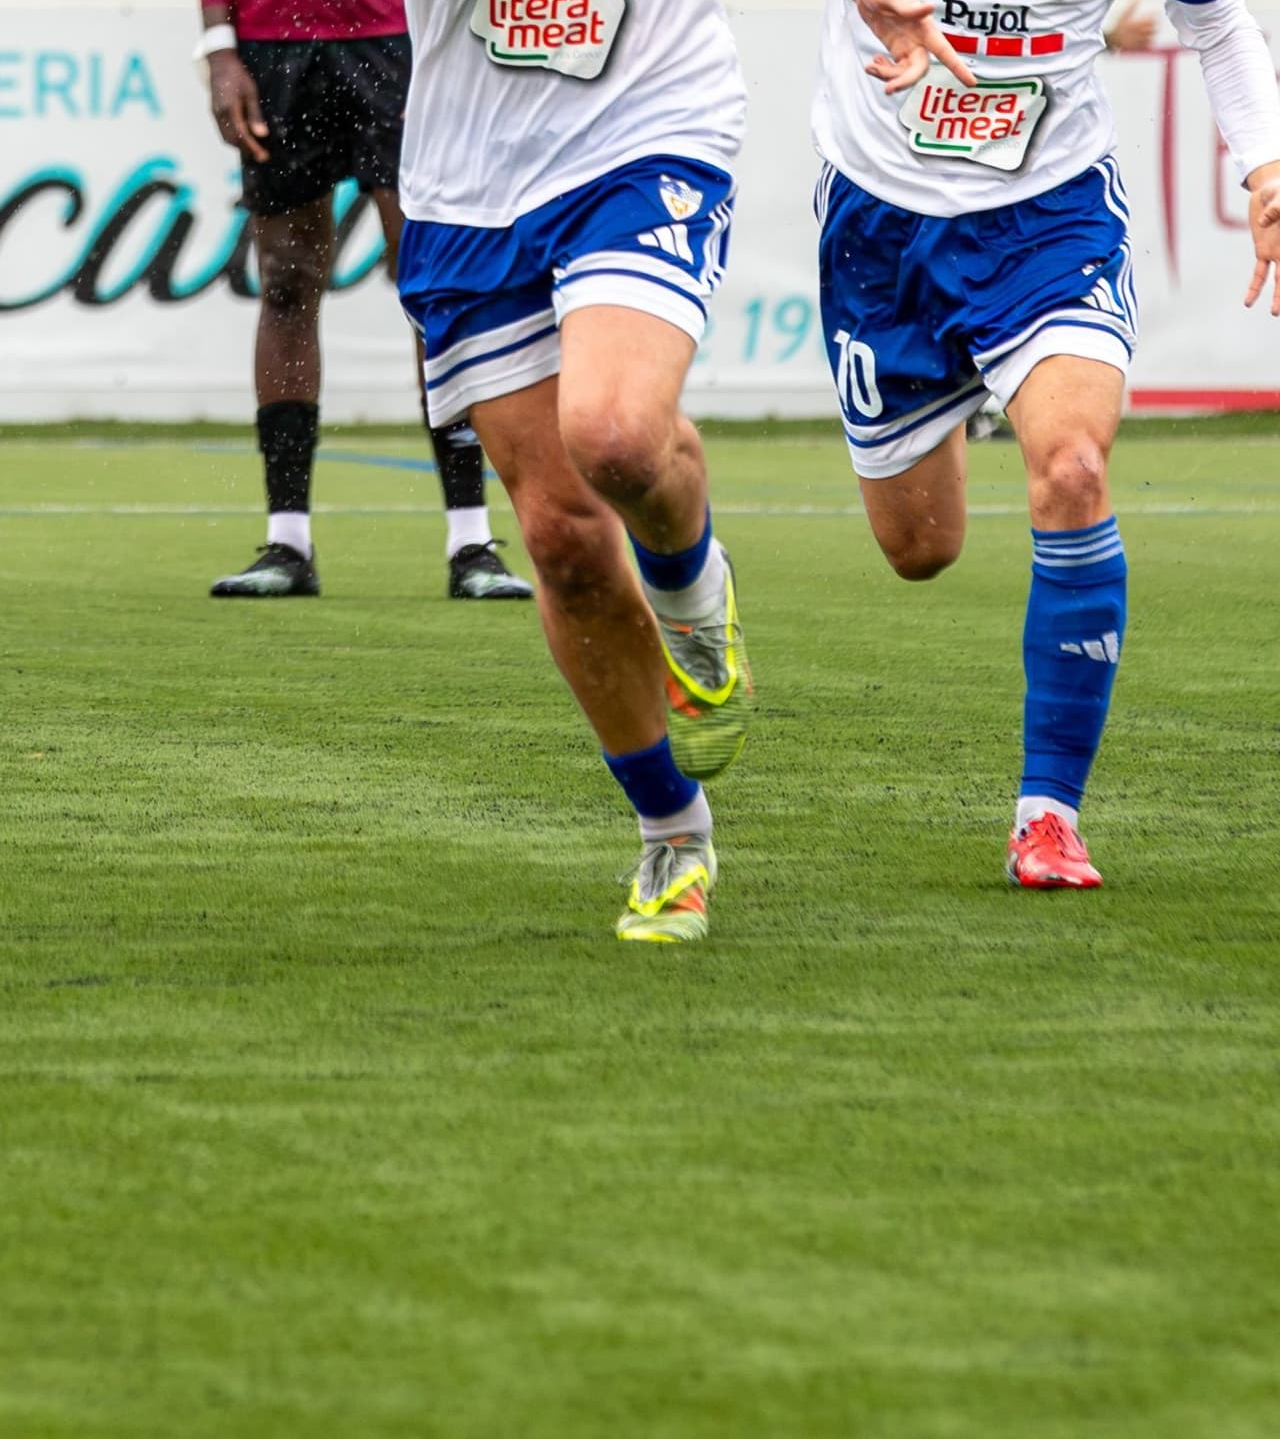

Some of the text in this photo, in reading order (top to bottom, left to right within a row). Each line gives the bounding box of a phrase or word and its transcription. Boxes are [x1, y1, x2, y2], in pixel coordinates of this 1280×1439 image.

[508, 10, 606, 48] meat
[919, 84, 1018, 123] litera
[935, 109, 1027, 141] meat
[832, 327, 884, 420] 10
